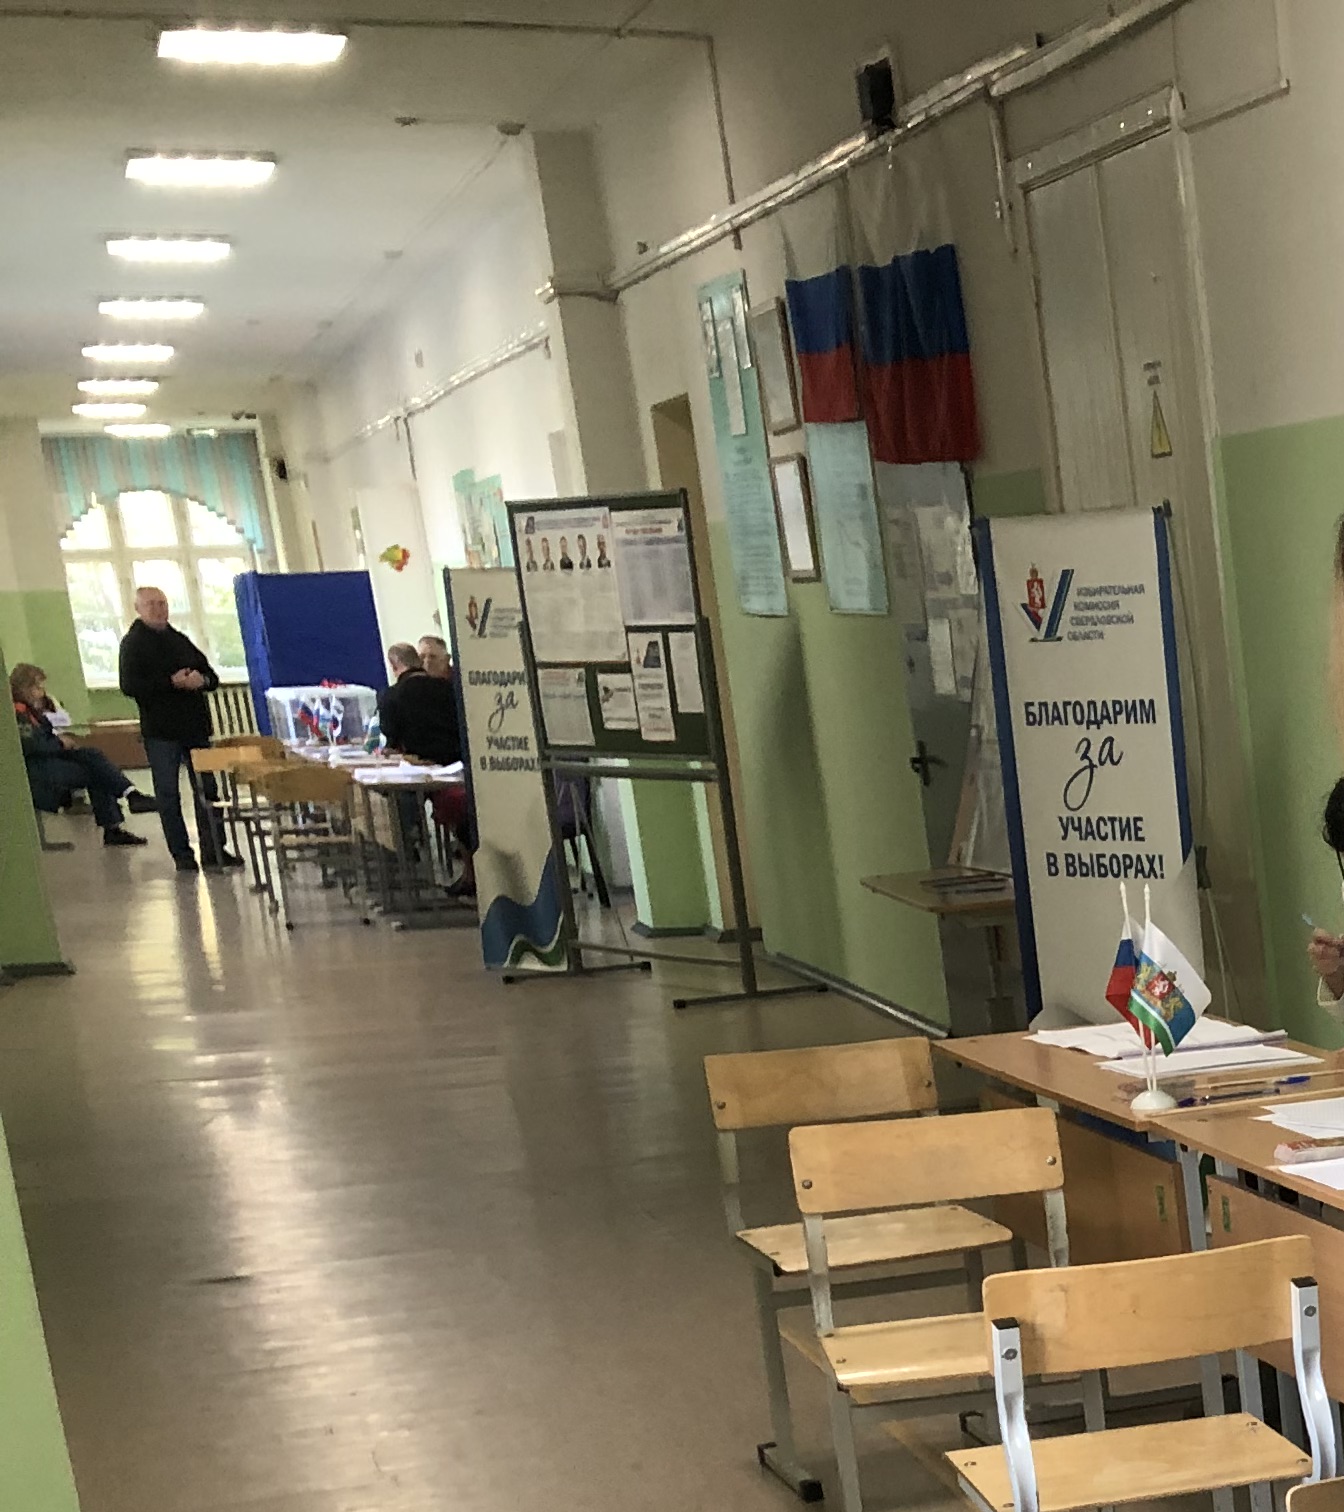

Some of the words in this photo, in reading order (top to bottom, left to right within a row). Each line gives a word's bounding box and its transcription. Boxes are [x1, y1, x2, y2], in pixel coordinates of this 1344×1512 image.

[468, 669, 527, 688] БЛАГОДАРИ
[1024, 699, 1157, 730] БЛАГОДАРИМ
[1063, 735, 1124, 812] за
[1058, 815, 1146, 842] УЧАСТИЕ
[1045, 852, 1060, 877] В
[1064, 852, 1165, 880] ВЫБОРАХ!
